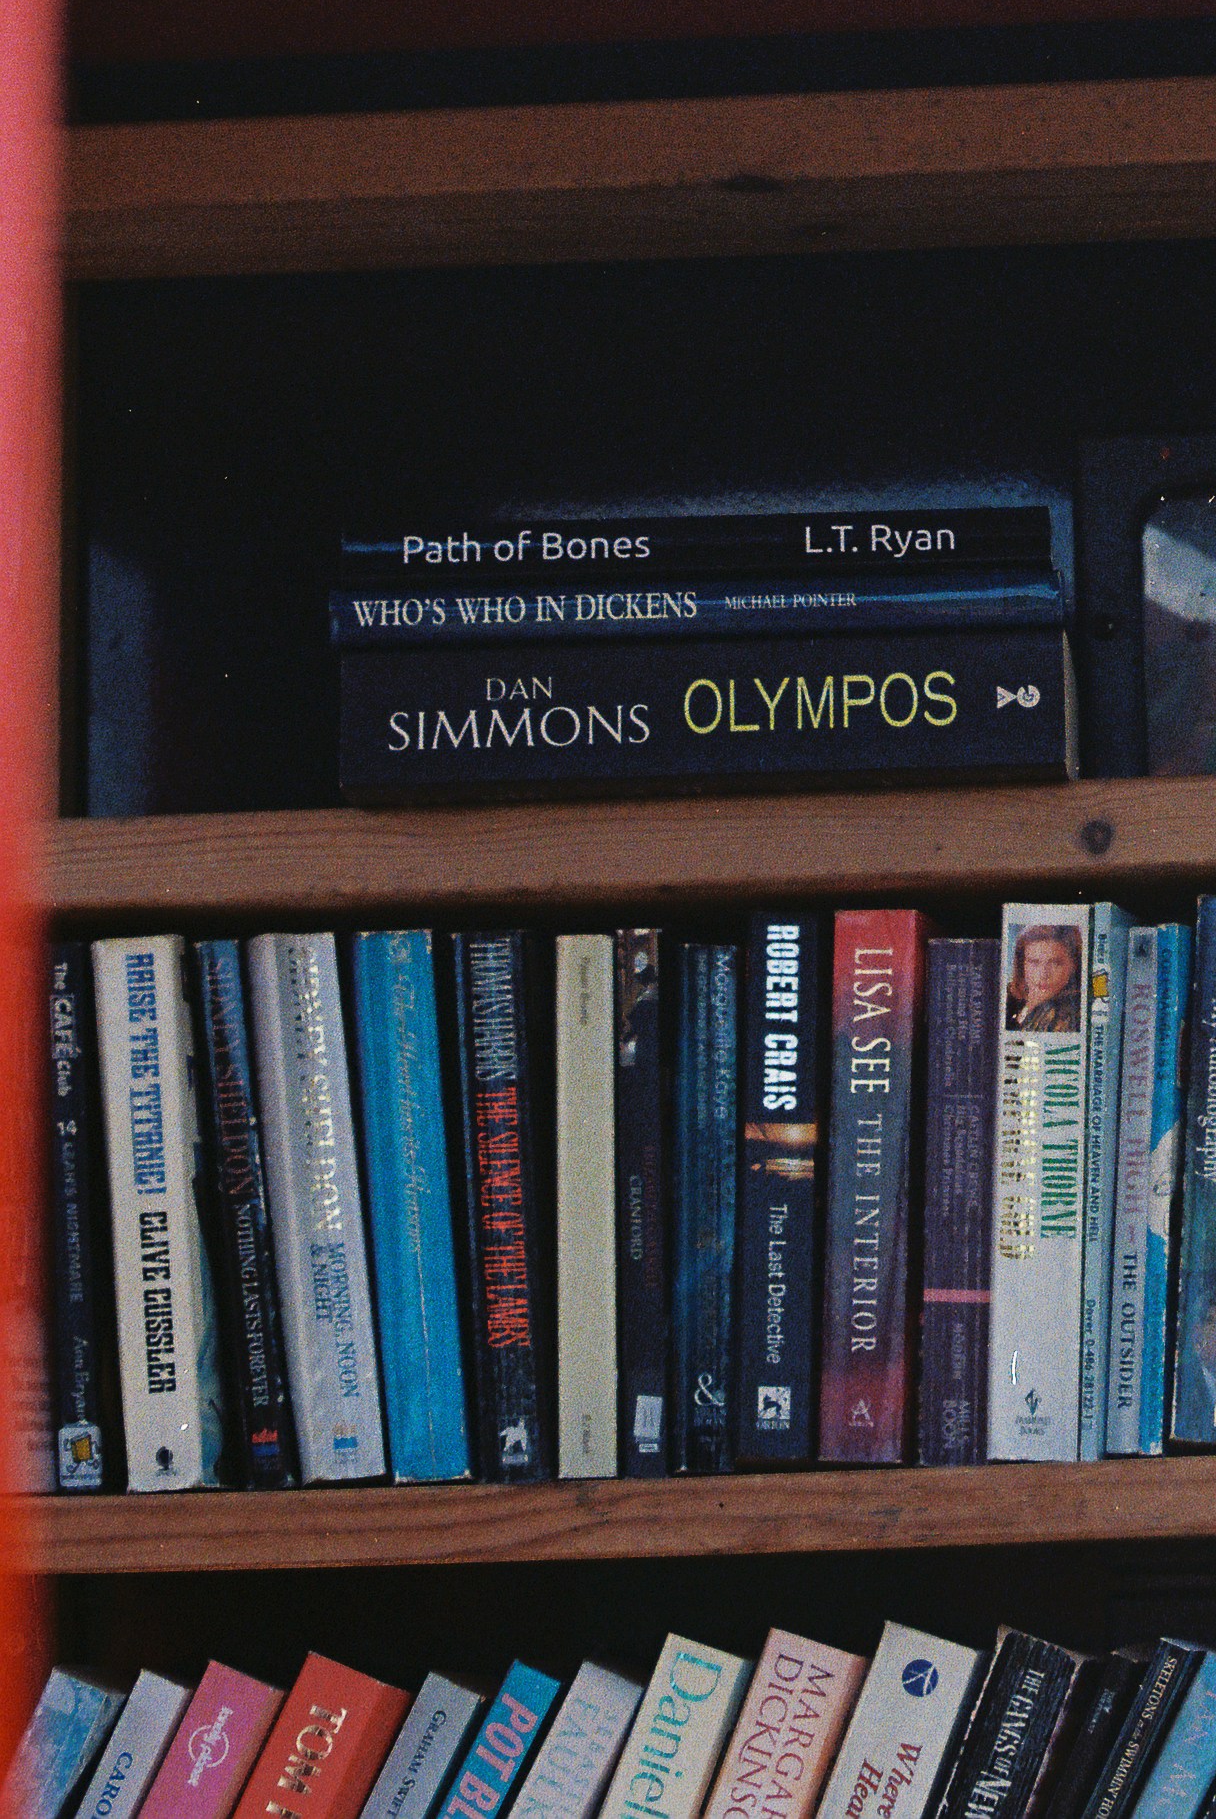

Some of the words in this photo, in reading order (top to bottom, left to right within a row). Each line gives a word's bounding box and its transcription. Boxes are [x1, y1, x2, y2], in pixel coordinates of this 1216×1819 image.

[402, 534, 482, 565] Path
[494, 531, 532, 562] of
[542, 530, 651, 562] Bones
[804, 524, 859, 555] L.T.
[870, 523, 956, 559] Ryan
[354, 598, 447, 628] WHO'S
[456, 596, 525, 624] WHO
[536, 595, 565, 622] IN
[574, 590, 698, 621] DICKENS
[724, 594, 789, 610] MICHAEL
[793, 591, 857, 608] POINTER
[485, 676, 554, 702] DAN
[683, 670, 959, 736] OLYMPOS
[388, 704, 652, 752] SIMMONS
[53, 962, 68, 990] The
[125, 953, 156, 1023] RAISE
[205, 953, 234, 1055] SIDNEY
[469, 937, 513, 1015] THOMAS
[763, 923, 800, 1023] ROBERT
[852, 946, 893, 1022] LISA
[52, 996, 81, 1057] CAFÉ
[710, 953, 731, 1063] Marguerite
[1093, 1024, 1105, 1053] THE
[56, 1059, 73, 1097] Club
[130, 1028, 160, 1079] THE
[473, 1017, 516, 1081] HARRIS
[850, 1036, 891, 1095] SEE
[1126, 982, 1151, 1124] ROSWELL
[476, 1086, 518, 1127] THE
[712, 1069, 731, 1119] Kaye
[1042, 1041, 1082, 1130] NICOLA
[1091, 1054, 1104, 1113] MARRIAGE
[128, 1084, 166, 1197] TITANIC!
[210, 1061, 251, 1196] SHELDON
[854, 1114, 883, 1177] THE
[1090, 1115, 1102, 1131] OF
[477, 1131, 521, 1204] SILENCE
[1040, 1138, 1080, 1240] THORNE
[1089, 1134, 1101, 1182] HEAVEN
[1124, 1135, 1150, 1215] HIGH
[481, 1211, 522, 1234] OF
[768, 1204, 789, 1237] The
[1087, 1215, 1099, 1242] HELL
[1088, 1186, 1100, 1213] AND
[65, 1203, 85, 1303] NIGHTMARE
[139, 1211, 170, 1280] CLIVE
[233, 1203, 258, 1280] NOTHING
[310, 1242, 325, 1257] &
[482, 1241, 527, 1279] THE
[767, 1241, 789, 1279] Last
[1122, 1252, 1139, 1291] THE
[312, 1259, 333, 1323] NIGHT
[850, 1193, 881, 1354] INTERIOR
[237, 1282, 263, 1331] LASTS
[486, 1279, 531, 1348] LAMBS
[765, 1283, 788, 1364] Detective
[1085, 1298, 1096, 1334] Dover
[143, 1288, 176, 1394] CUSSLER
[244, 1333, 270, 1407] FOREVER
[337, 1341, 360, 1399] NOON
[1117, 1301, 1137, 1410] OUTSIDER
[1021, 1668, 1045, 1696] THE
[1140, 1655, 1179, 1720] SKELETONS
[275, 1703, 348, 1797] TOM
[406, 1708, 447, 1782] GRAHAM
[474, 1692, 539, 1783] POT
[622, 1651, 723, 1819] Daniel
[994, 1694, 1035, 1758] GANGS
[93, 1750, 134, 1819] CARO
[445, 1771, 500, 1819] BL
[876, 1741, 923, 1819] Where
[990, 1758, 1012, 1776] OF
[1107, 1740, 1141, 1800] SWIMMIN'
